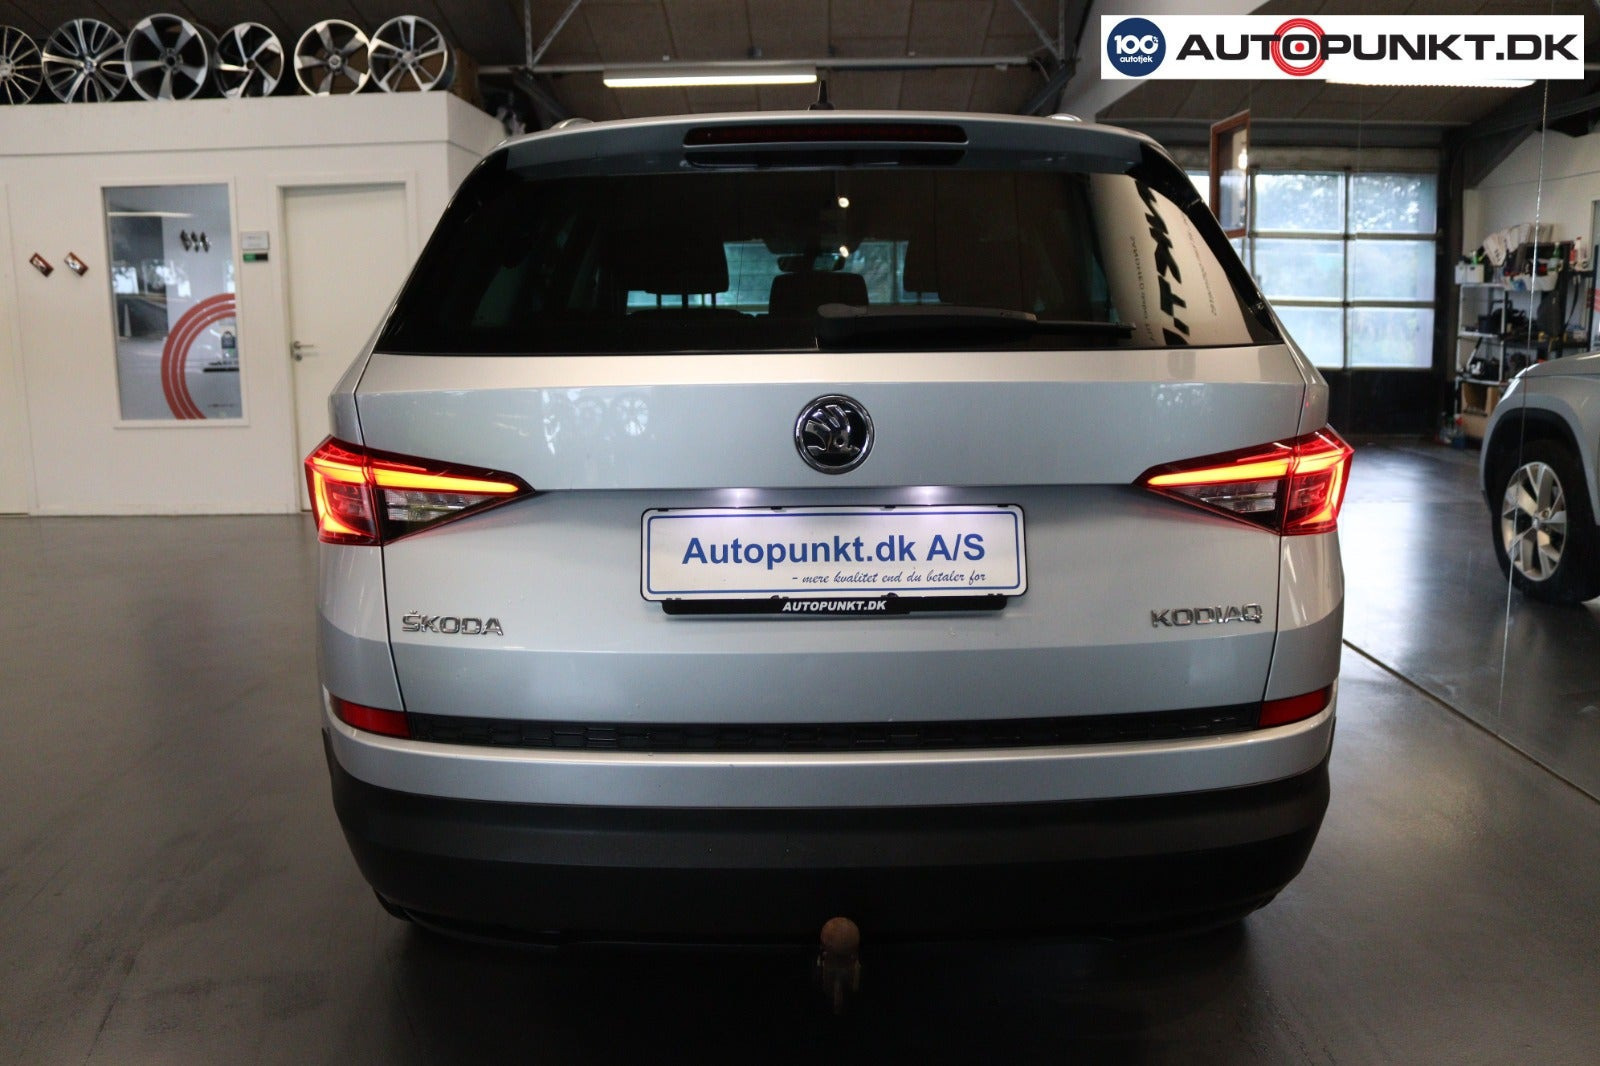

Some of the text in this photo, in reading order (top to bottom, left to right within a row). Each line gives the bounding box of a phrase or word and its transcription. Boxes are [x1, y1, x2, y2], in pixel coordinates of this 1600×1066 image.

[681, 533, 986, 570] Autopunkt.dk A/S
[802, 574, 830, 584] mere
[833, 570, 879, 584] kvalitet
[881, 570, 904, 583] end
[906, 570, 922, 583] du
[926, 569, 965, 583] betaler
[968, 569, 987, 586] for
[782, 600, 888, 612] AUTOPUNKT.DK
[1150, 603, 1262, 628] KODIAQ
[402, 609, 504, 636] ŠKODA
